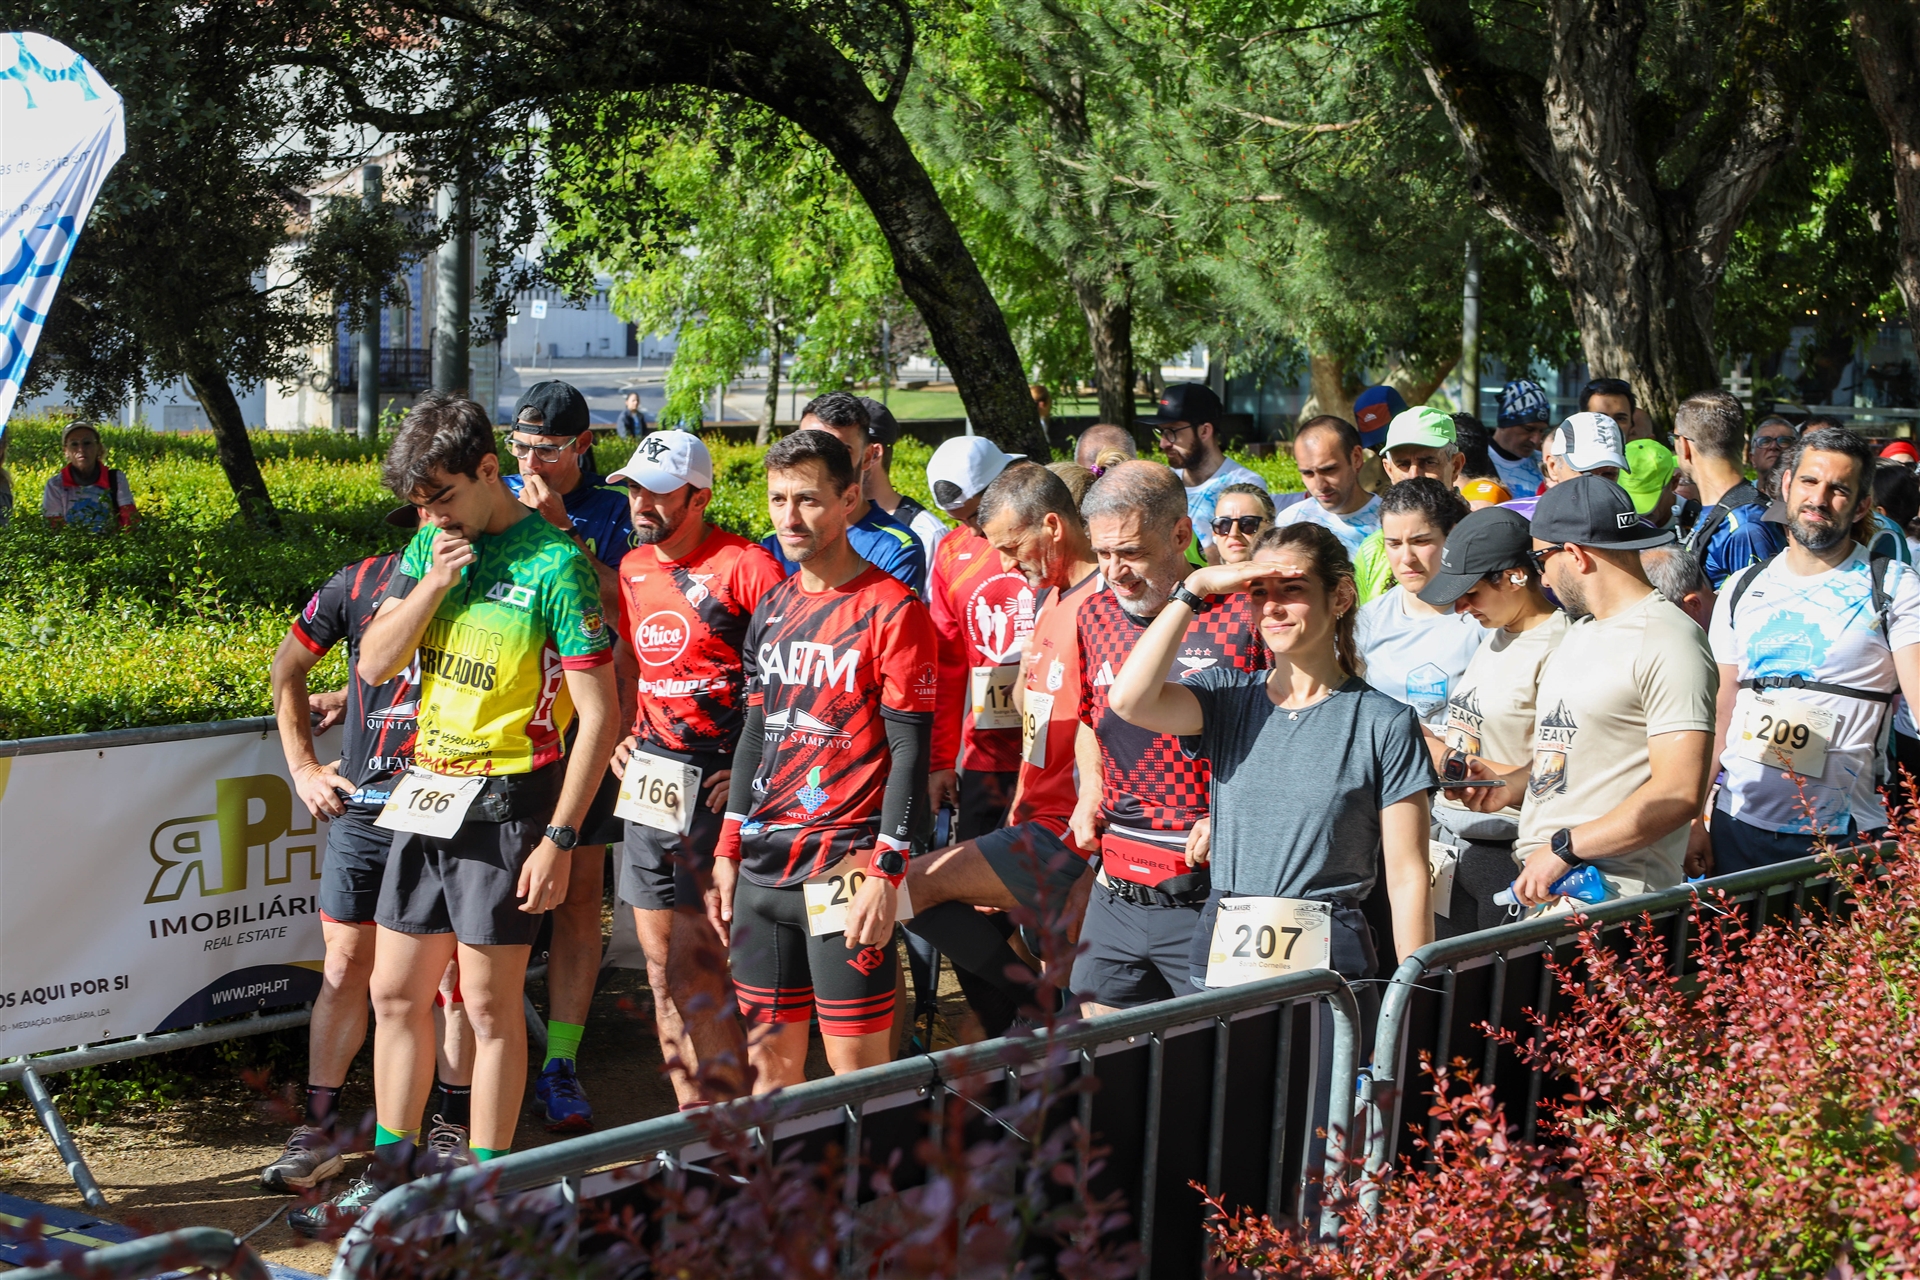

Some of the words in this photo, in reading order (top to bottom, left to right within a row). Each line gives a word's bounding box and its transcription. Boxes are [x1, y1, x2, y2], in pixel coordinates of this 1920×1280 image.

[16, 160, 31, 173] de
[638, 437, 671, 463] NY
[421, 616, 504, 665] MUNDOS
[638, 623, 682, 648] Chico
[421, 646, 496, 692] CRUZADOS
[366, 718, 411, 732] QUINTA
[1756, 714, 1810, 750] 209
[790, 732, 852, 750] SAMPAYO
[408, 787, 456, 814] 186
[637, 774, 679, 809] 166
[1122, 852, 1177, 873] LURBEL
[149, 893, 323, 939] IMOBILIÁRI
[203, 936, 234, 951] REAL
[236, 926, 288, 945] ESTATE
[1232, 924, 1304, 961] 207
[20, 984, 65, 1005] AQUI
[70, 978, 110, 997] POR
[114, 974, 129, 991] SI
[211, 978, 290, 1006] WWW.RPH.PT
[12, 1018, 52, 1030] MEDIAÇÃO
[52, 1010, 97, 1024] IMOBILIÁRIA,
[97, 1007, 111, 1017] LDA
